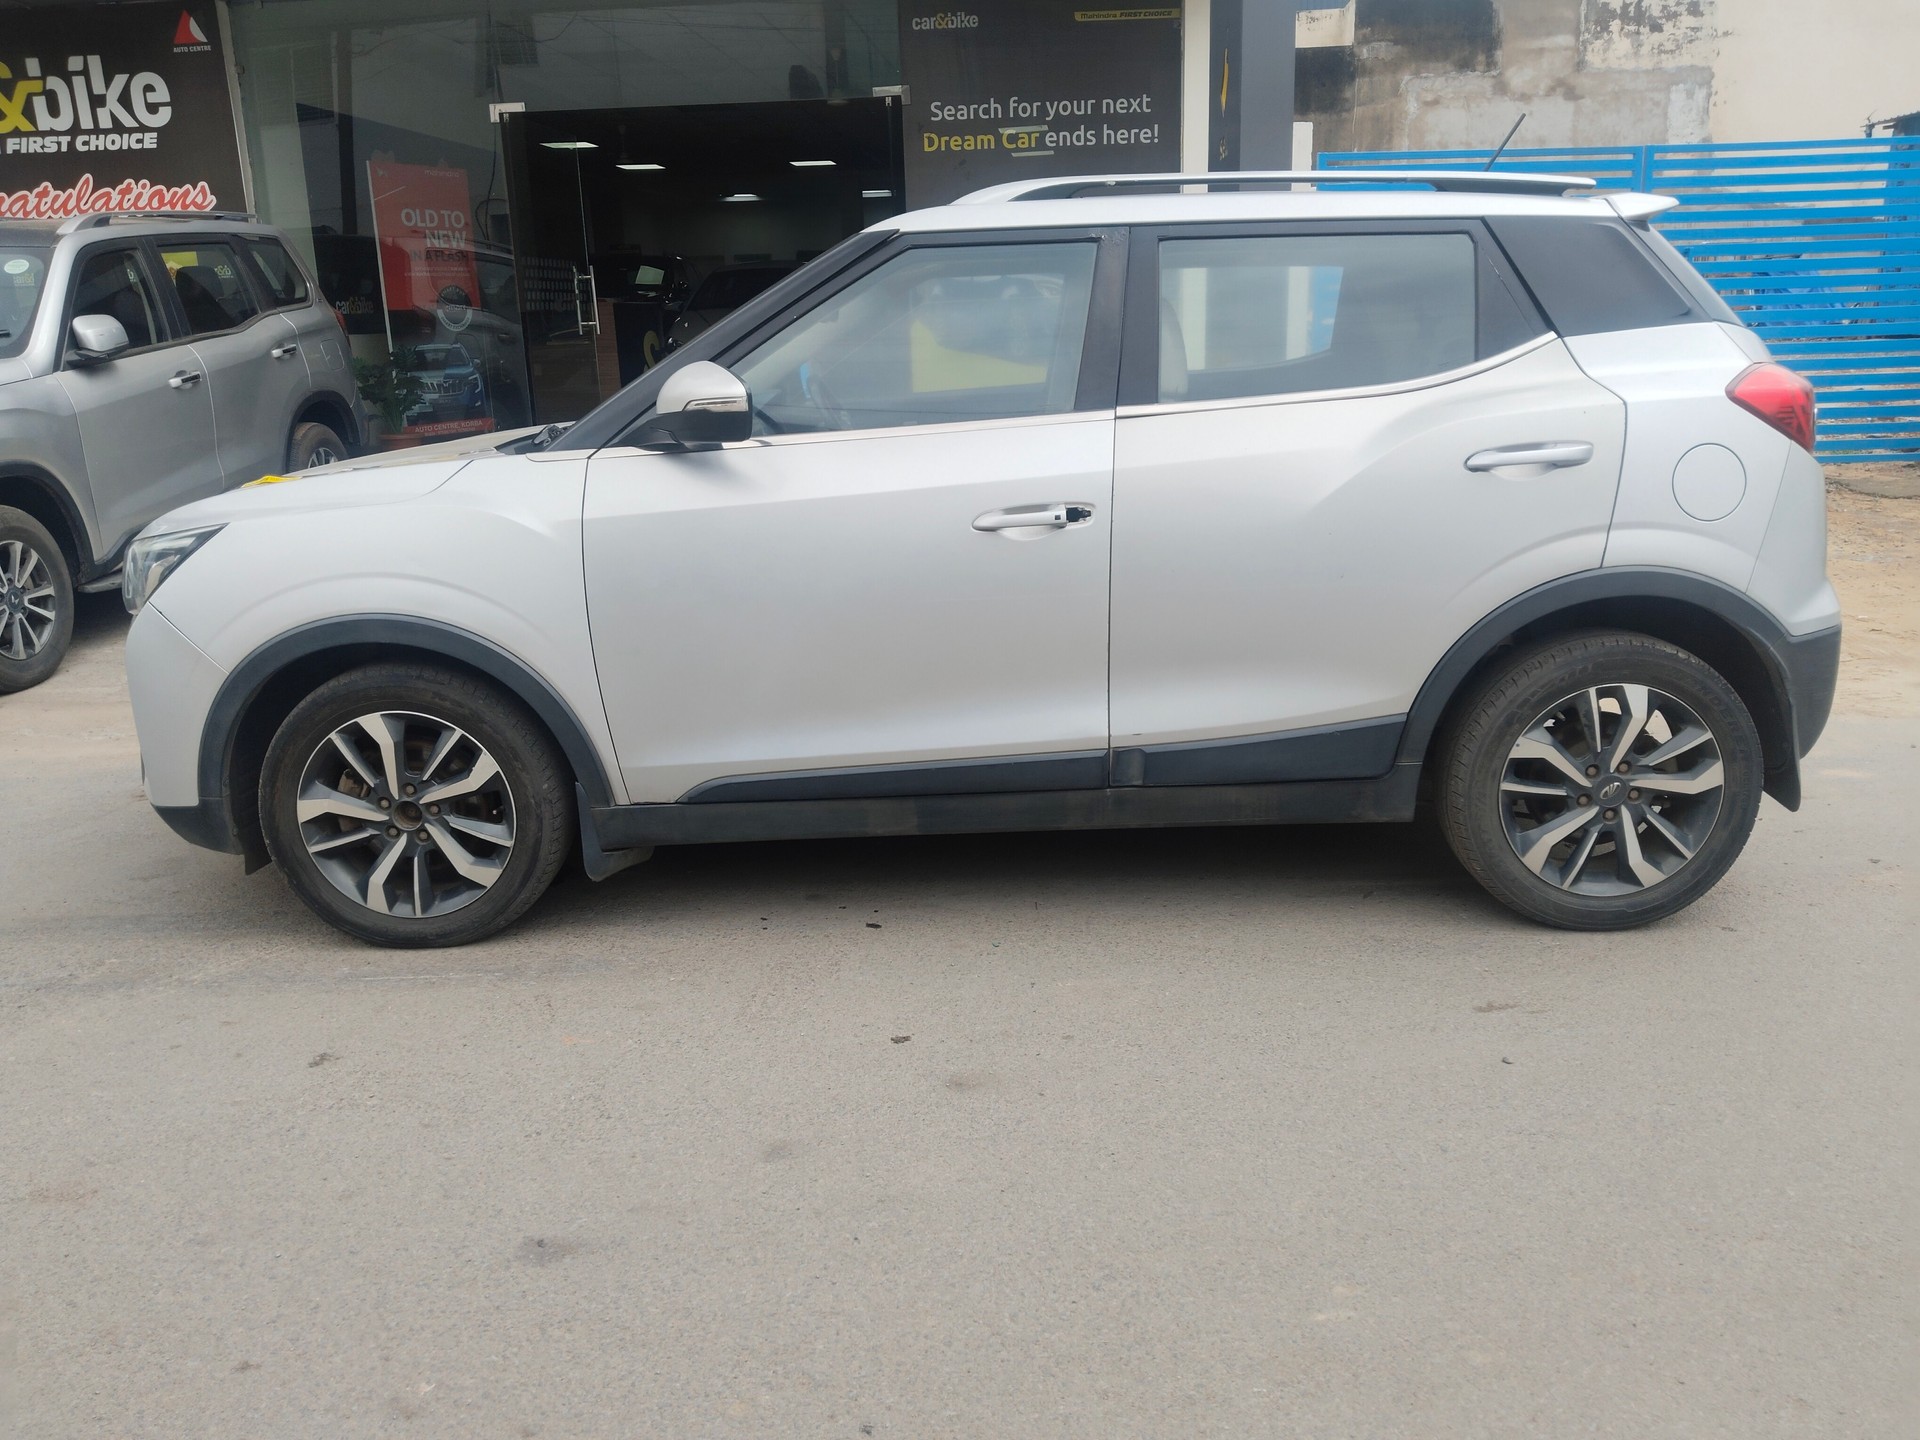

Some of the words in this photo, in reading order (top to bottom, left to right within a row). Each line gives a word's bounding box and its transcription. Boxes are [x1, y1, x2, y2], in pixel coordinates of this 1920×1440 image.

[912, 12, 979, 31] car&bike
[1080, 12, 1117, 20] Mahindra
[930, 97, 1002, 122] Search
[1009, 96, 1042, 118] for
[1045, 99, 1096, 121] your
[1102, 94, 1152, 115] next
[6, 135, 72, 154] FIRST
[75, 132, 158, 152] CHOICE
[923, 132, 995, 152] Dream
[1002, 130, 1040, 149] Car
[1045, 125, 1097, 147] ends
[1103, 124, 1160, 146] here!
[400, 207, 439, 228] OLD
[440, 209, 465, 229] TO
[425, 230, 467, 249] NEW
